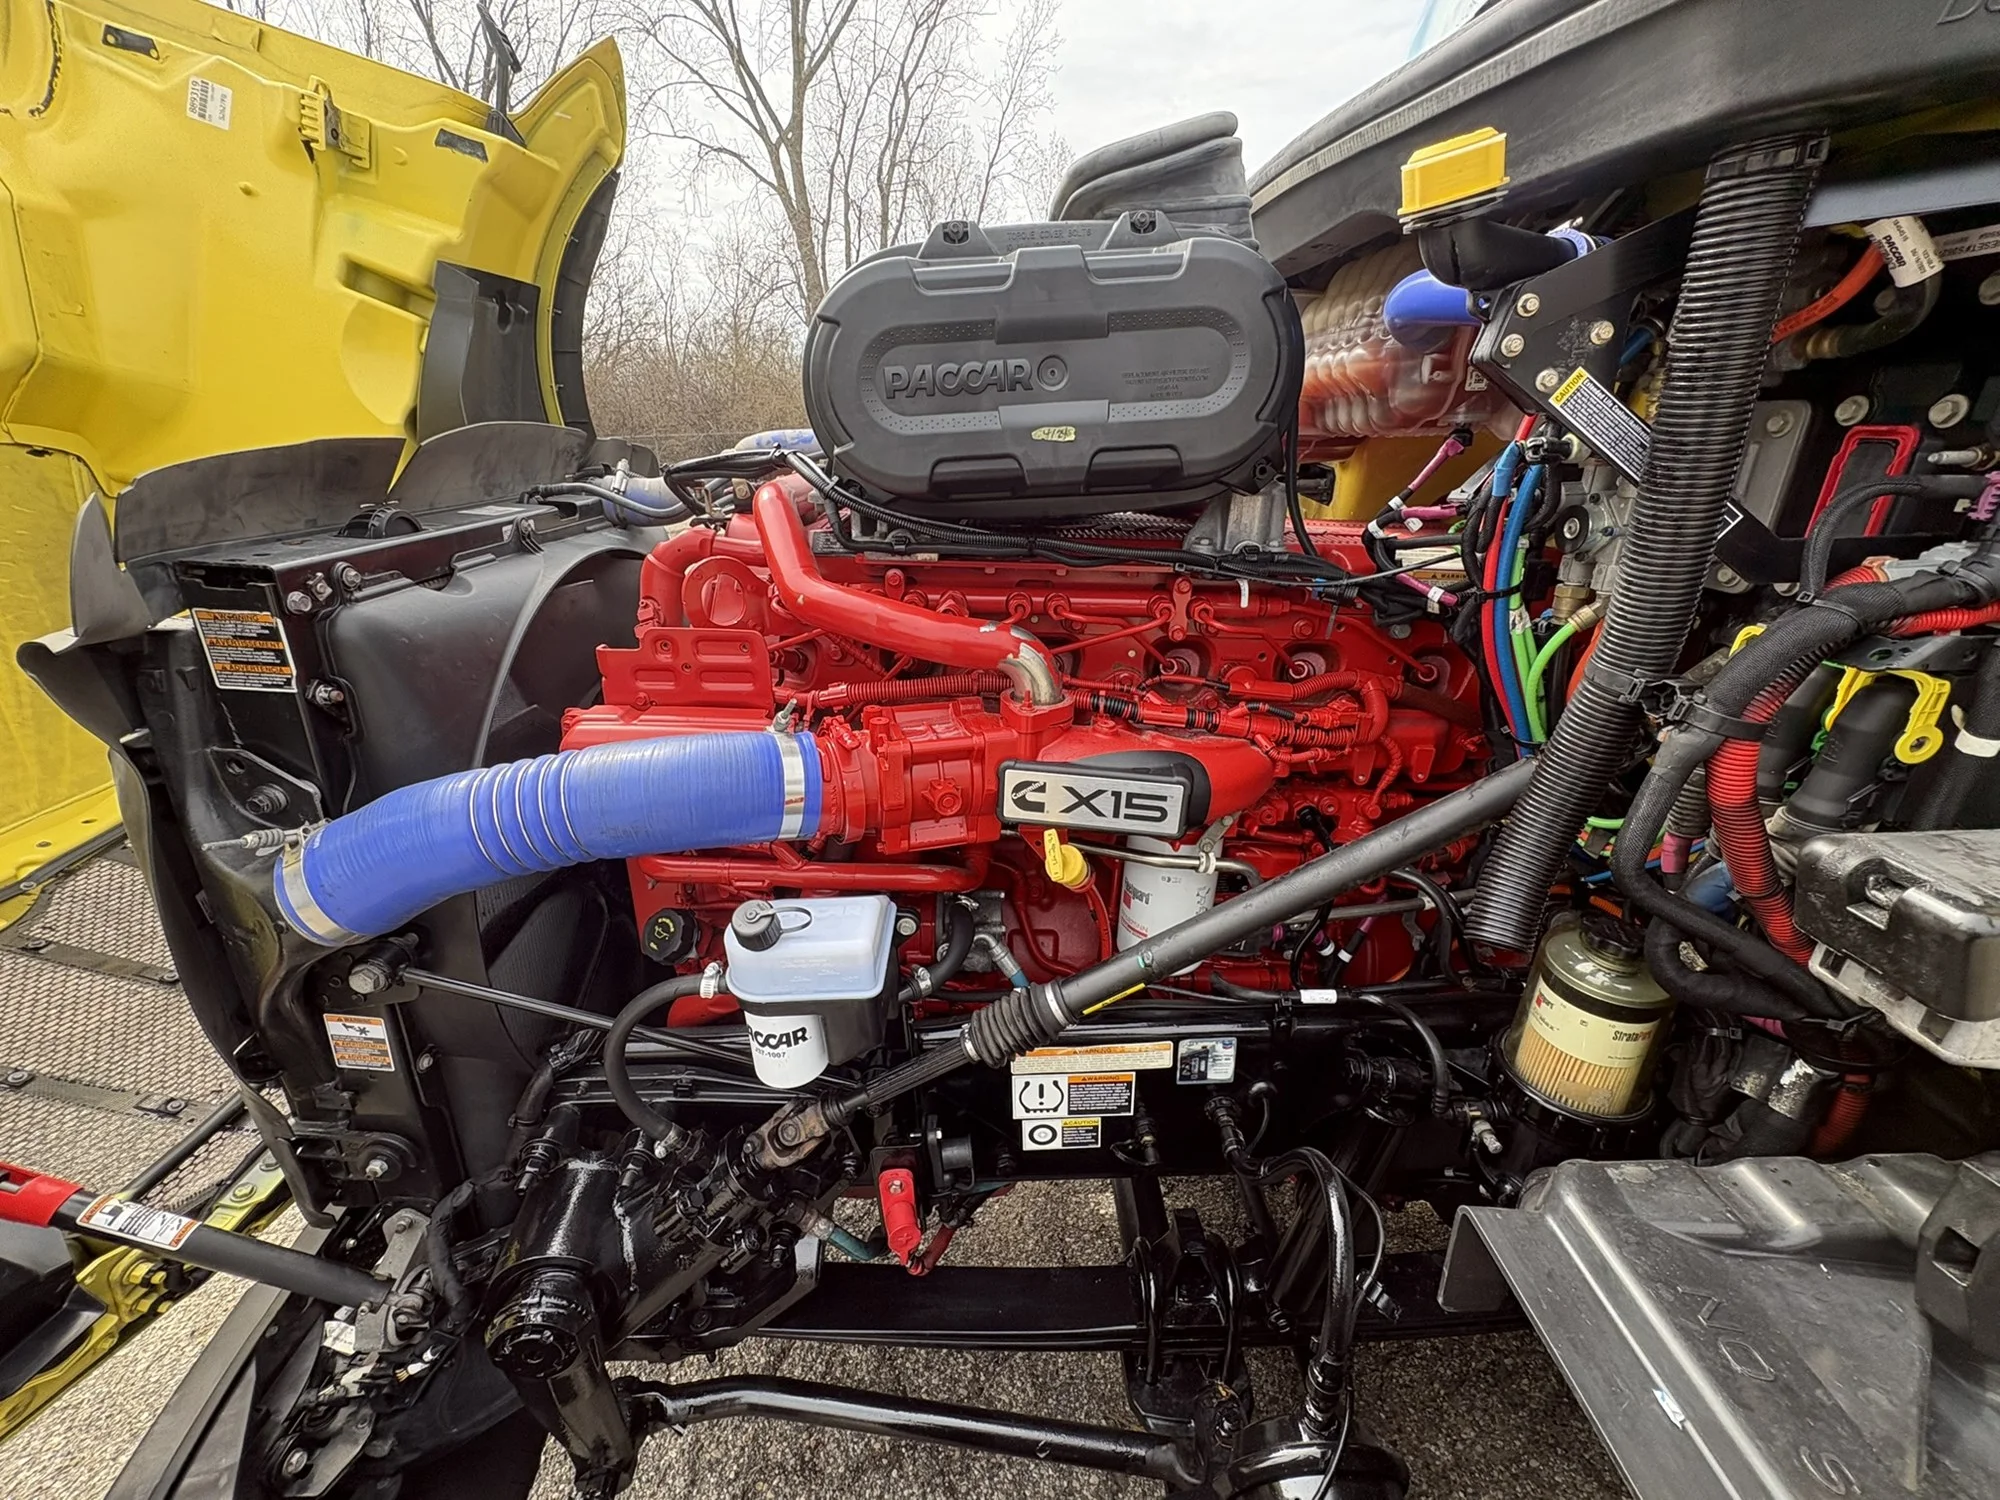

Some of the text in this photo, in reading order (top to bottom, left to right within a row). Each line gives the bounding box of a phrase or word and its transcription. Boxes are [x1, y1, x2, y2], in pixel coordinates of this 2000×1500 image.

[1882, 234, 1907, 267] PACCAR
[883, 358, 1034, 399] PACCAR
[1554, 372, 1584, 403] CAUTION
[1583, 379, 1605, 400] Extended
[1011, 781, 1168, 822] Cummins X15
[747, 1024, 809, 1050] ACCAR
